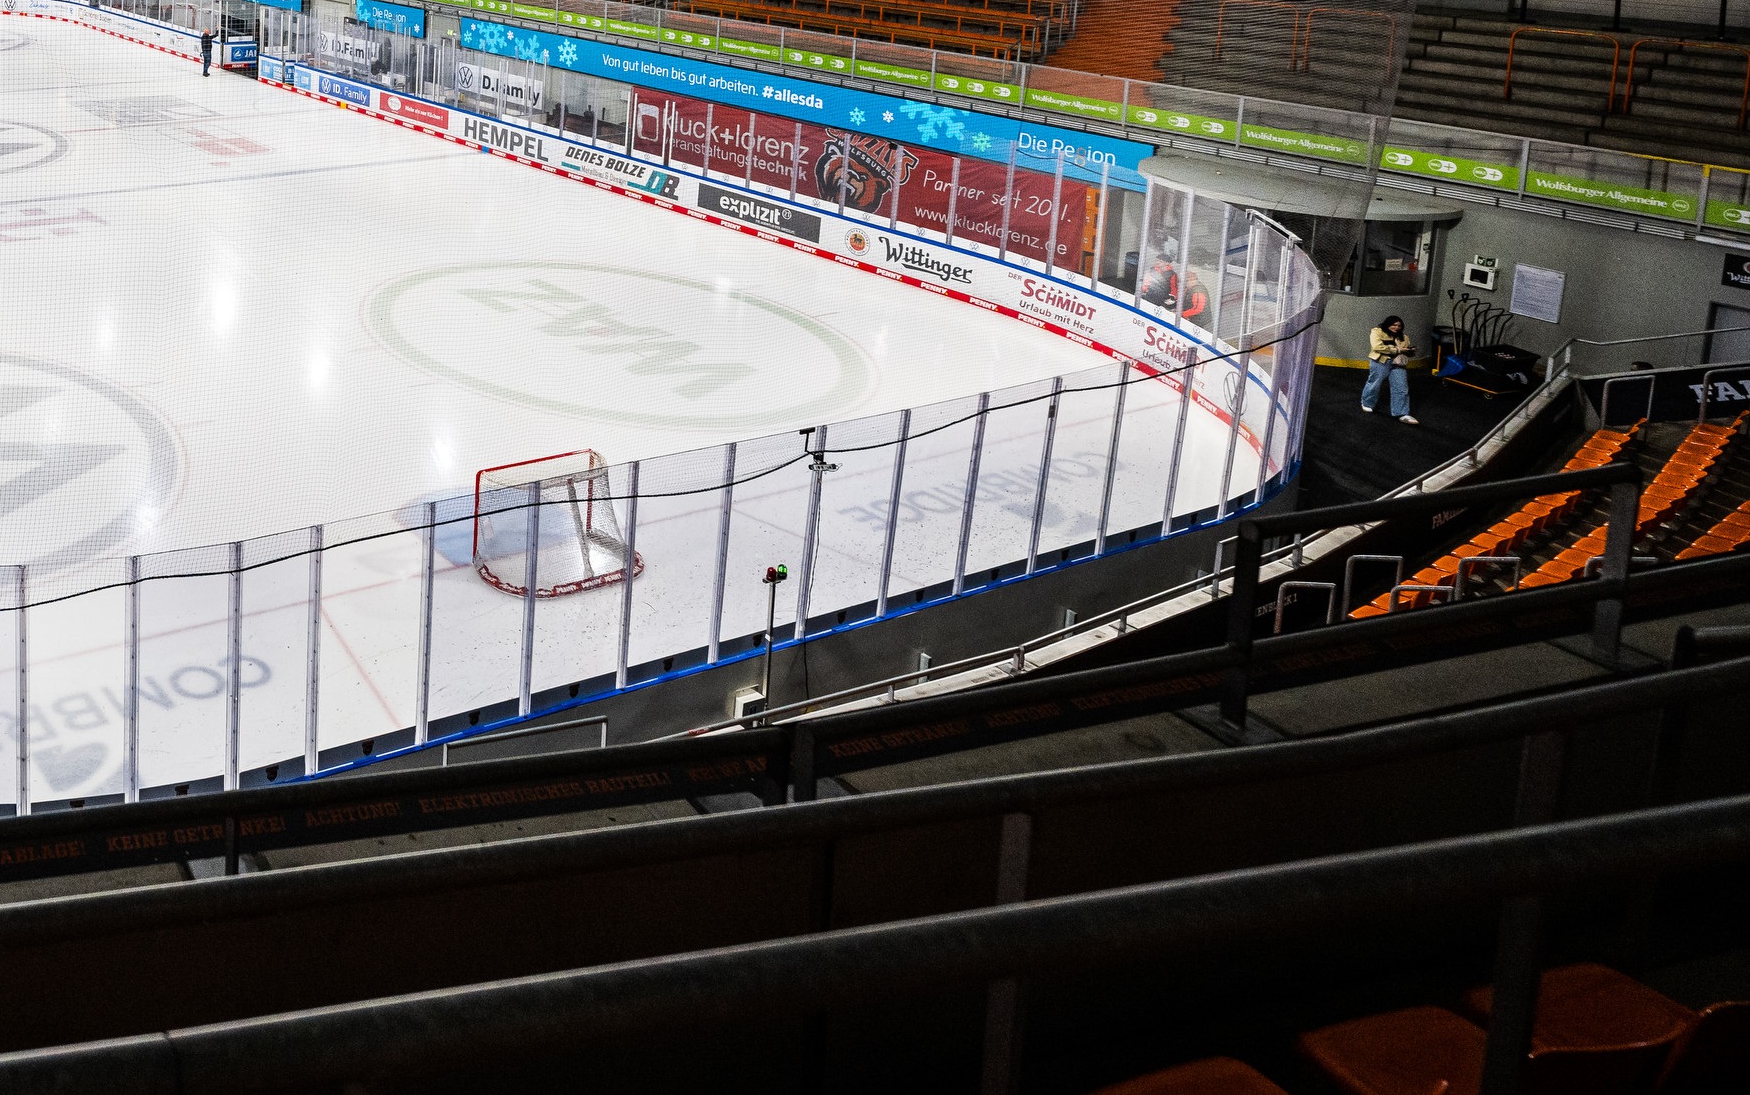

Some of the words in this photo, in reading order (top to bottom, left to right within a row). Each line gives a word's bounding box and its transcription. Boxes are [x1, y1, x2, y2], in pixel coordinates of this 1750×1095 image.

[372, 7, 382, 18] Die
[343, 85, 368, 105] Family
[602, 53, 620, 68] Von
[622, 59, 640, 73] gut
[640, 60, 668, 78] leben
[671, 66, 687, 81] bis
[688, 72, 706, 87] gut
[708, 76, 758, 97] arbeiten.
[762, 85, 824, 110] #allesda
[1031, 93, 1071, 108] Wolfsburger
[1071, 99, 1107, 114] Allgemeine
[464, 117, 549, 162] HEMPEL
[1018, 131, 1048, 153] Die
[1245, 130, 1299, 146] Wolfsburger
[1299, 138, 1344, 154] Allgemeine
[565, 145, 605, 167] DENES
[605, 156, 646, 178] BOLZE
[838, 140, 887, 177] WLFSBURG
[609, 173, 627, 186] Design
[1536, 178, 1605, 198] Wolfsburger
[1605, 190, 1668, 208] Allgemeine
[923, 169, 985, 201] Parner
[991, 190, 1022, 209] set
[1024, 195, 1072, 223] 201.
[878, 236, 973, 284] Wittinger
[1008, 271, 1023, 282] DER
[1019, 299, 1052, 318] Urlaub
[1054, 312, 1071, 326] mit
[1072, 318, 1094, 335] Herz
[1132, 317, 1146, 328] DER
[106, 826, 170, 853] KEINE
[172, 815, 287, 848] GETRNKE!
[305, 801, 402, 828] ACHTUNG!
